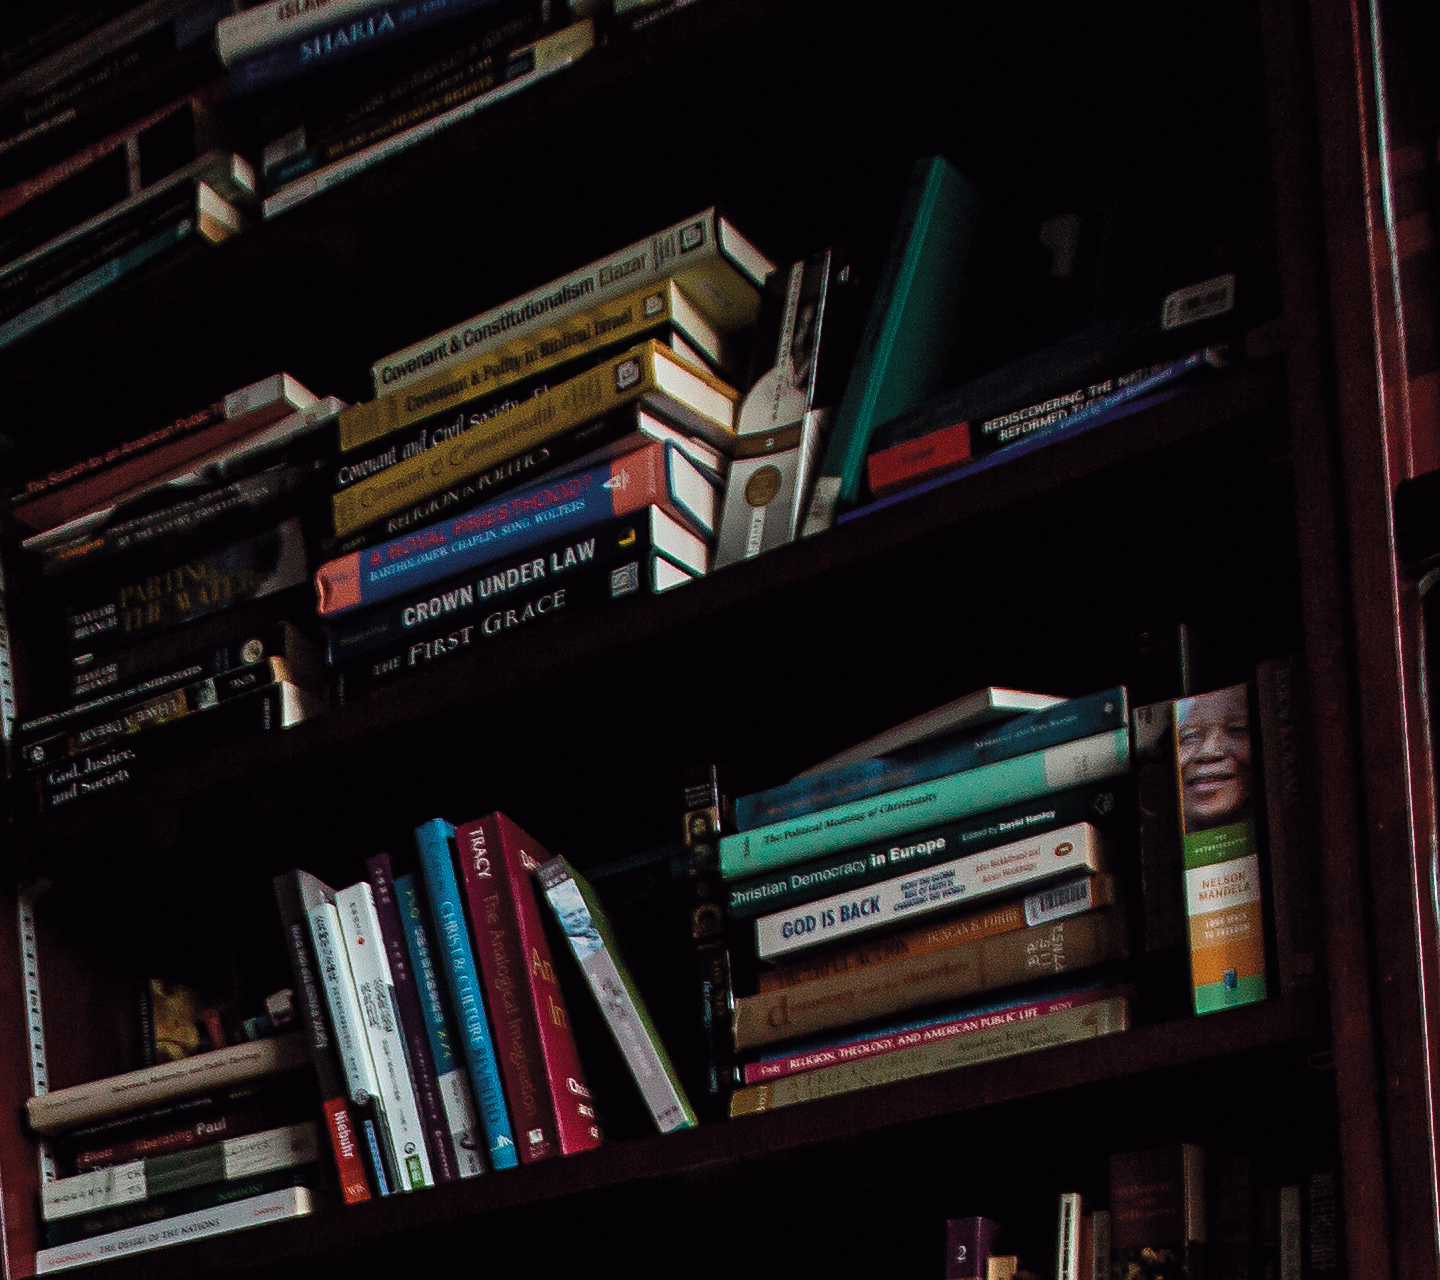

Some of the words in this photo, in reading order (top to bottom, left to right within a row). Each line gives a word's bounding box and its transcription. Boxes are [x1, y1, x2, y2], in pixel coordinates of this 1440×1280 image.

[381, 341, 449, 385] Covenant
[450, 333, 460, 354] &
[463, 277, 595, 347] Constitutionalism
[401, 585, 474, 628] CROWN
[477, 557, 546, 599] UNDER
[550, 538, 596, 573] LAW
[407, 625, 475, 666] FIRST
[479, 587, 568, 637] GRACE
[467, 826, 492, 879] TRACY
[791, 859, 868, 893] Democracy
[869, 850, 886, 867] in
[889, 836, 947, 866] Europe
[781, 916, 817, 940] GOD
[821, 907, 835, 929] IS
[839, 895, 882, 925] BACK
